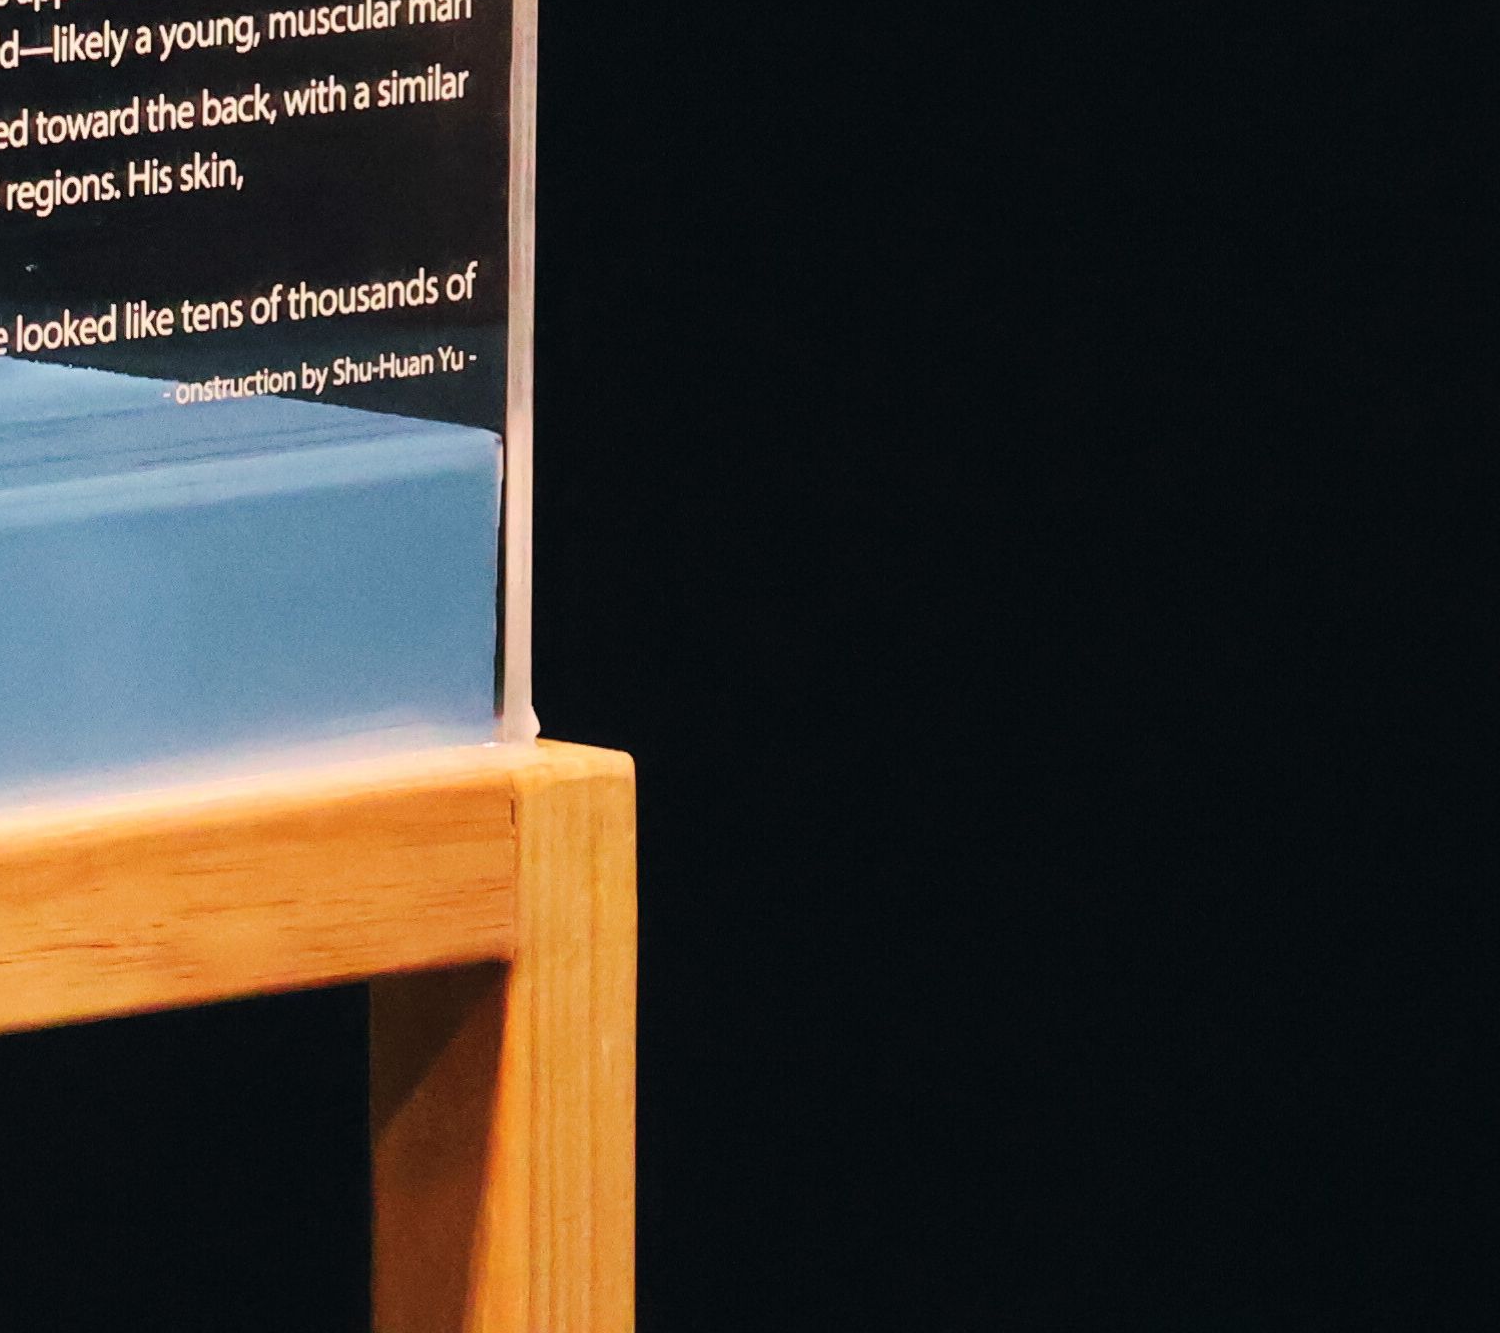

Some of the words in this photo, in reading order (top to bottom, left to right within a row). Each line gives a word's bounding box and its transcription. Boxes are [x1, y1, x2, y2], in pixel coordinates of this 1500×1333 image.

[134, 25, 151, 54] a
[158, 15, 260, 61] young,
[35, 96, 139, 144] toward
[146, 93, 194, 132] the
[202, 82, 276, 126] back,
[283, 74, 345, 116] with
[353, 81, 369, 109] a
[377, 63, 469, 106] similar
[6, 169, 120, 217] regions.
[128, 158, 172, 196] His
[180, 151, 243, 191] skin,
[16, 303, 116, 352] looked
[125, 299, 173, 339] like
[181, 299, 243, 333] tens
[250, 283, 282, 324] of
[287, 267, 438, 320] thousands
[445, 260, 477, 301] of
[175, 368, 296, 405] onstruction
[302, 362, 329, 395] by
[333, 350, 434, 387] Shu-Huan
[438, 345, 465, 371] Yu
